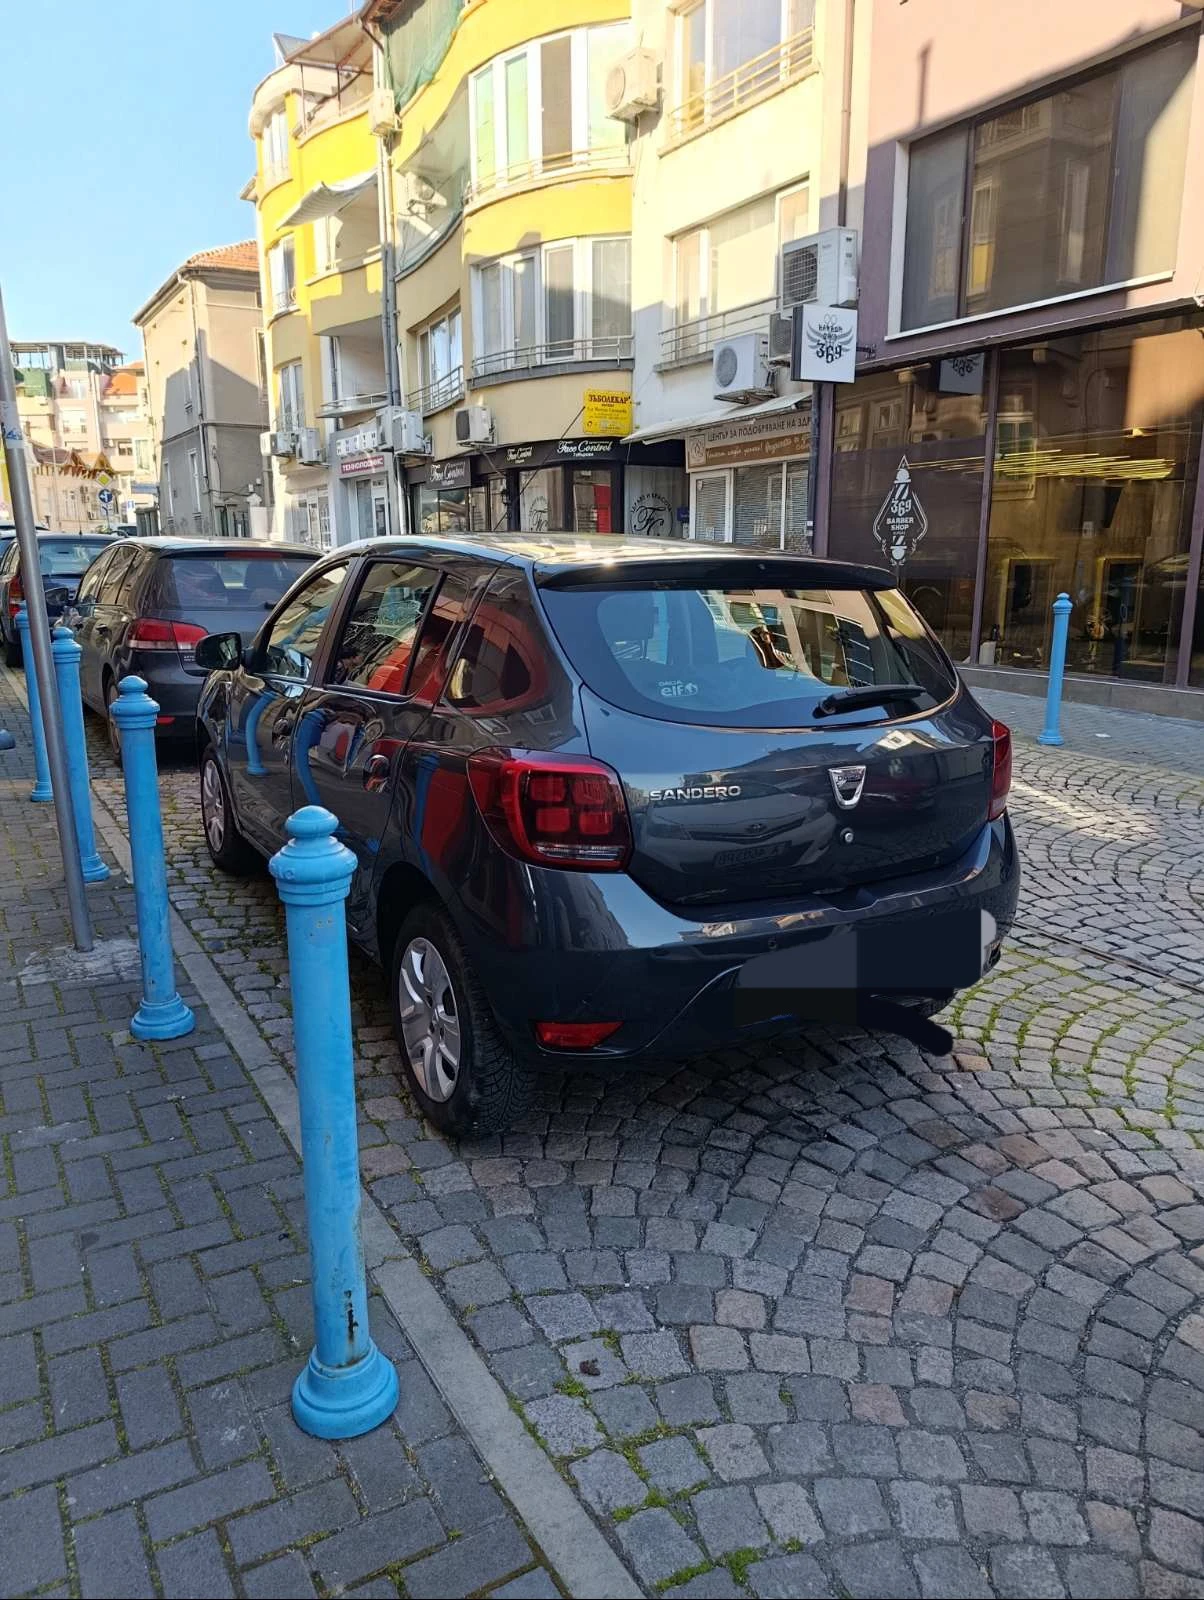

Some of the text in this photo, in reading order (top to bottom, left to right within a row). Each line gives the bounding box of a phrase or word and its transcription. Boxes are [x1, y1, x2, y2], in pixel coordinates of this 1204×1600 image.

[816, 339, 842, 364] 369
[707, 430, 729, 442] ЦЕНТЪР
[730, 431, 737, 439] ЗА
[786, 420, 796, 430] НА
[557, 440, 613, 454] Face Control
[890, 498, 912, 517] 369
[886, 517, 914, 525] BARBER
[660, 684, 684, 696] elf
[649, 785, 741, 801] SANDERO
